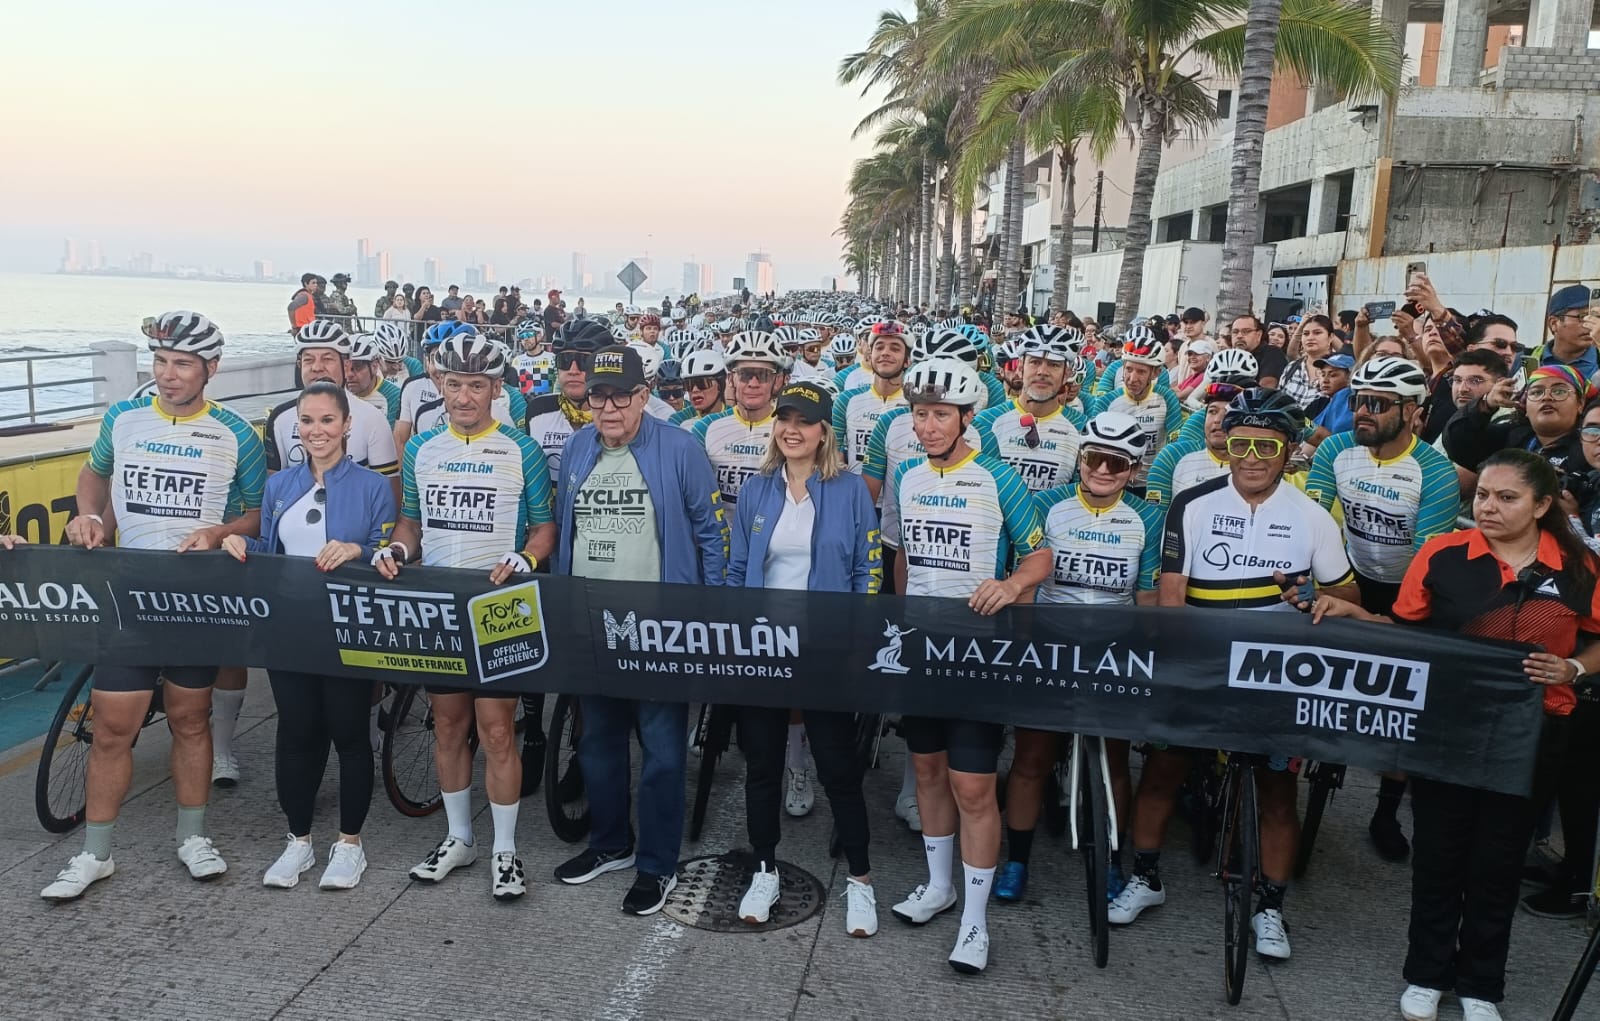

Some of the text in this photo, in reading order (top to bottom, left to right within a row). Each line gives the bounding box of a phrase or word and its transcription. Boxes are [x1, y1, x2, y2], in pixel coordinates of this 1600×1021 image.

[191, 432, 222, 441] Santini
[587, 472, 632, 488] BEST
[1232, 554, 1292, 570] CIBanco
[129, 590, 270, 618] TURISMO
[326, 583, 460, 631] L'ÉTAPE
[14, 613, 38, 622] DEL
[45, 614, 100, 623] ESTADO
[136, 614, 250, 627] SECRETARÍA DE TURISMO
[336, 628, 463, 652] MAZATLÁN
[604, 609, 800, 658] MAZATLÁN
[487, 648, 540, 670] EXPERIENCE
[493, 641, 530, 658] OFFICIAL
[926, 636, 1154, 680] MAZATLÁN
[384, 656, 409, 667] TOUR
[412, 658, 424, 668] DE
[425, 660, 463, 671] FRANCE
[618, 660, 793, 679] UN MAR DE HISTORIAS
[926, 668, 1154, 697] BIENESTAR PARA TODOS
[1234, 648, 1418, 702] MOTUL
[1296, 697, 1418, 742] BIKE CARE
